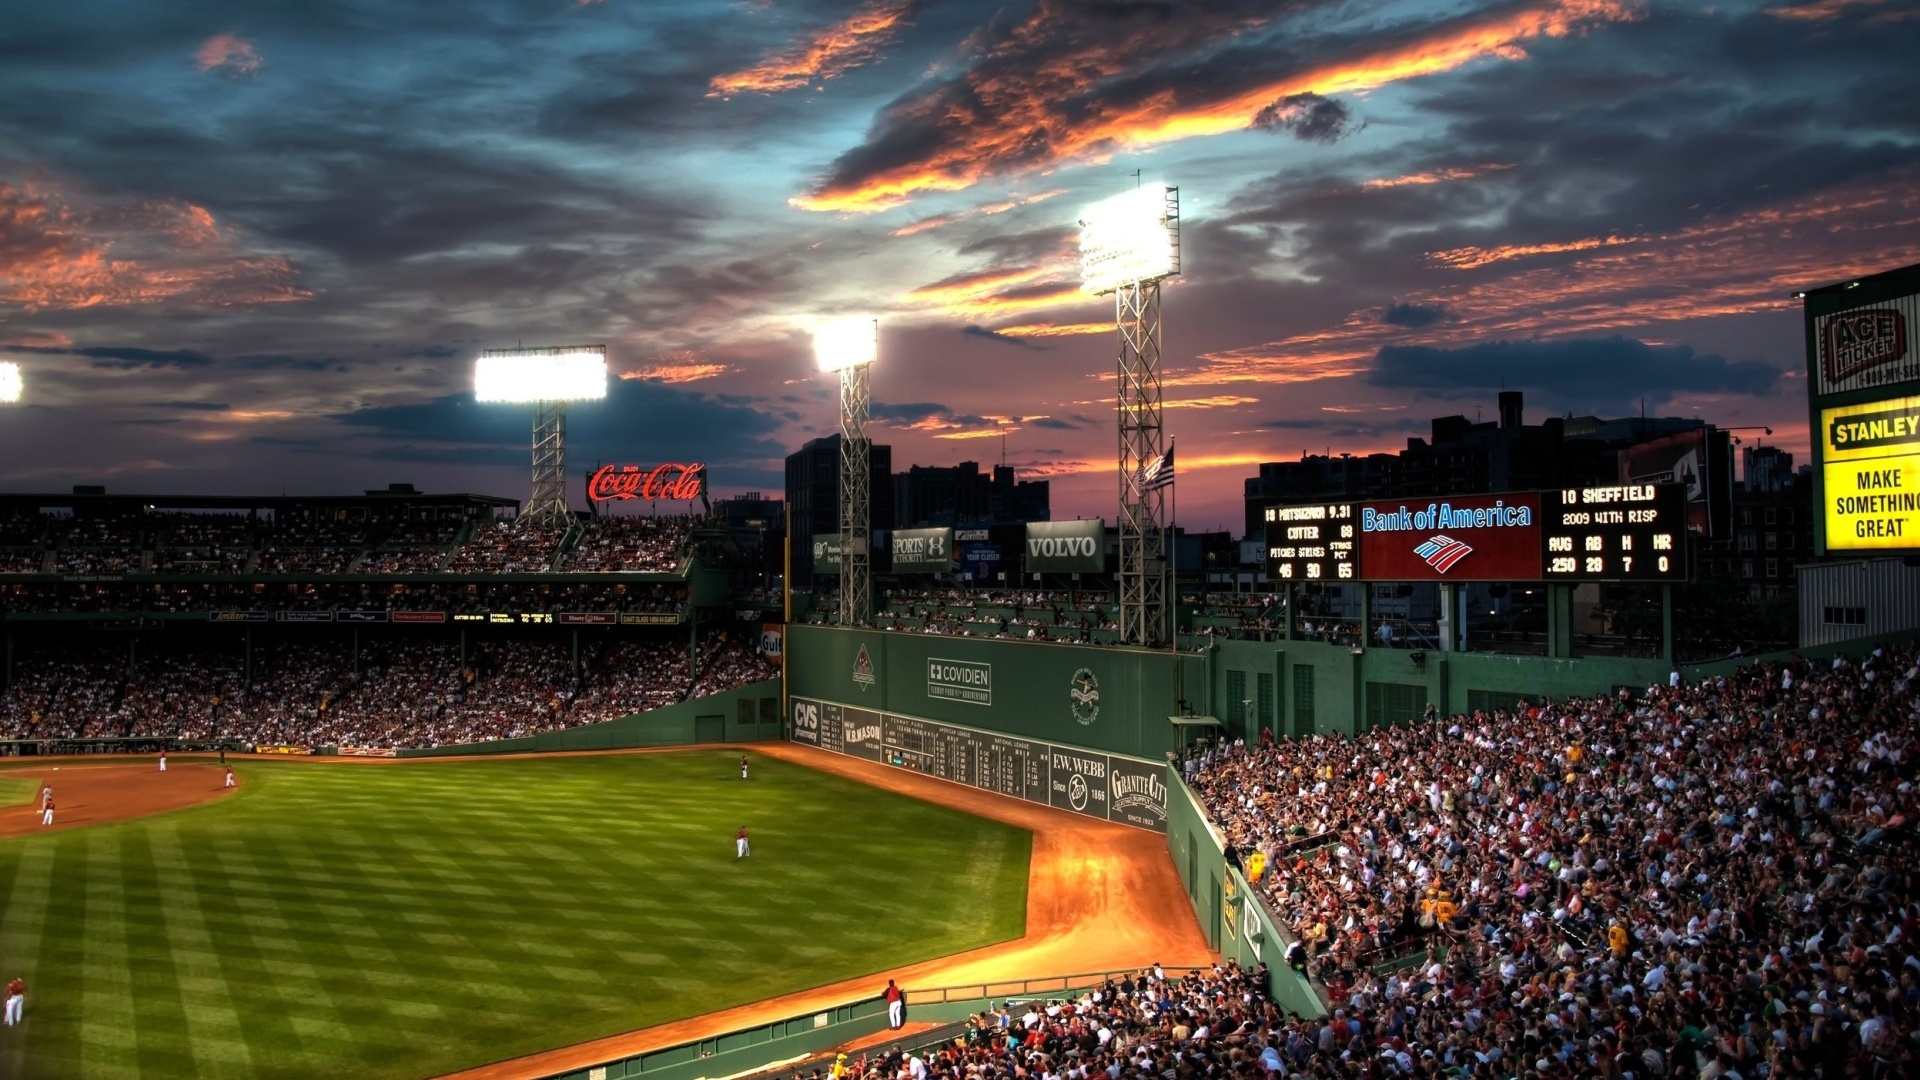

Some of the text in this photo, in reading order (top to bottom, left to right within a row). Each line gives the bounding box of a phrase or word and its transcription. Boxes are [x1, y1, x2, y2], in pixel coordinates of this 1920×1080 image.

[1837, 316, 1895, 350] ACE
[1838, 339, 1894, 370] TICKET
[1836, 415, 1920, 443] STANLEY
[589, 463, 705, 501] Coca-Cola
[1857, 469, 1902, 490] MAKE
[1562, 485, 1655, 504] 10 SHEFFIELD
[1329, 505, 1350, 518] 9.31
[1362, 500, 1531, 532] Bank of America
[1562, 510, 1657, 525] 2009 WITH RISP
[1288, 527, 1319, 539] CUTTER
[892, 537, 924, 554] SPORTS
[1028, 536, 1097, 558] VOLVO
[1548, 534, 1671, 551] AVG AB H HR
[1270, 547, 1324, 557] PITCHES STRIKES
[1334, 551, 1348, 559] PCT
[1279, 563, 1352, 578] 46 30 65
[1547, 556, 1668, 572] .250 28 7 0
[568, 614, 584, 622] Ninety
[943, 665, 988, 686] COVIDIEN
[795, 702, 818, 730] CVS
[795, 727, 819, 743] pharmacy
[995, 738, 1013, 747] NATIONAL
[1053, 753, 1105, 778] F.W. WEBB
[1053, 780, 1066, 792] Since
[1091, 788, 1105, 801] 1866
[1112, 769, 1149, 799] GRANITE
[1132, 795, 1151, 805] SUPPLY
[1127, 814, 1154, 826] SINCE 1923
